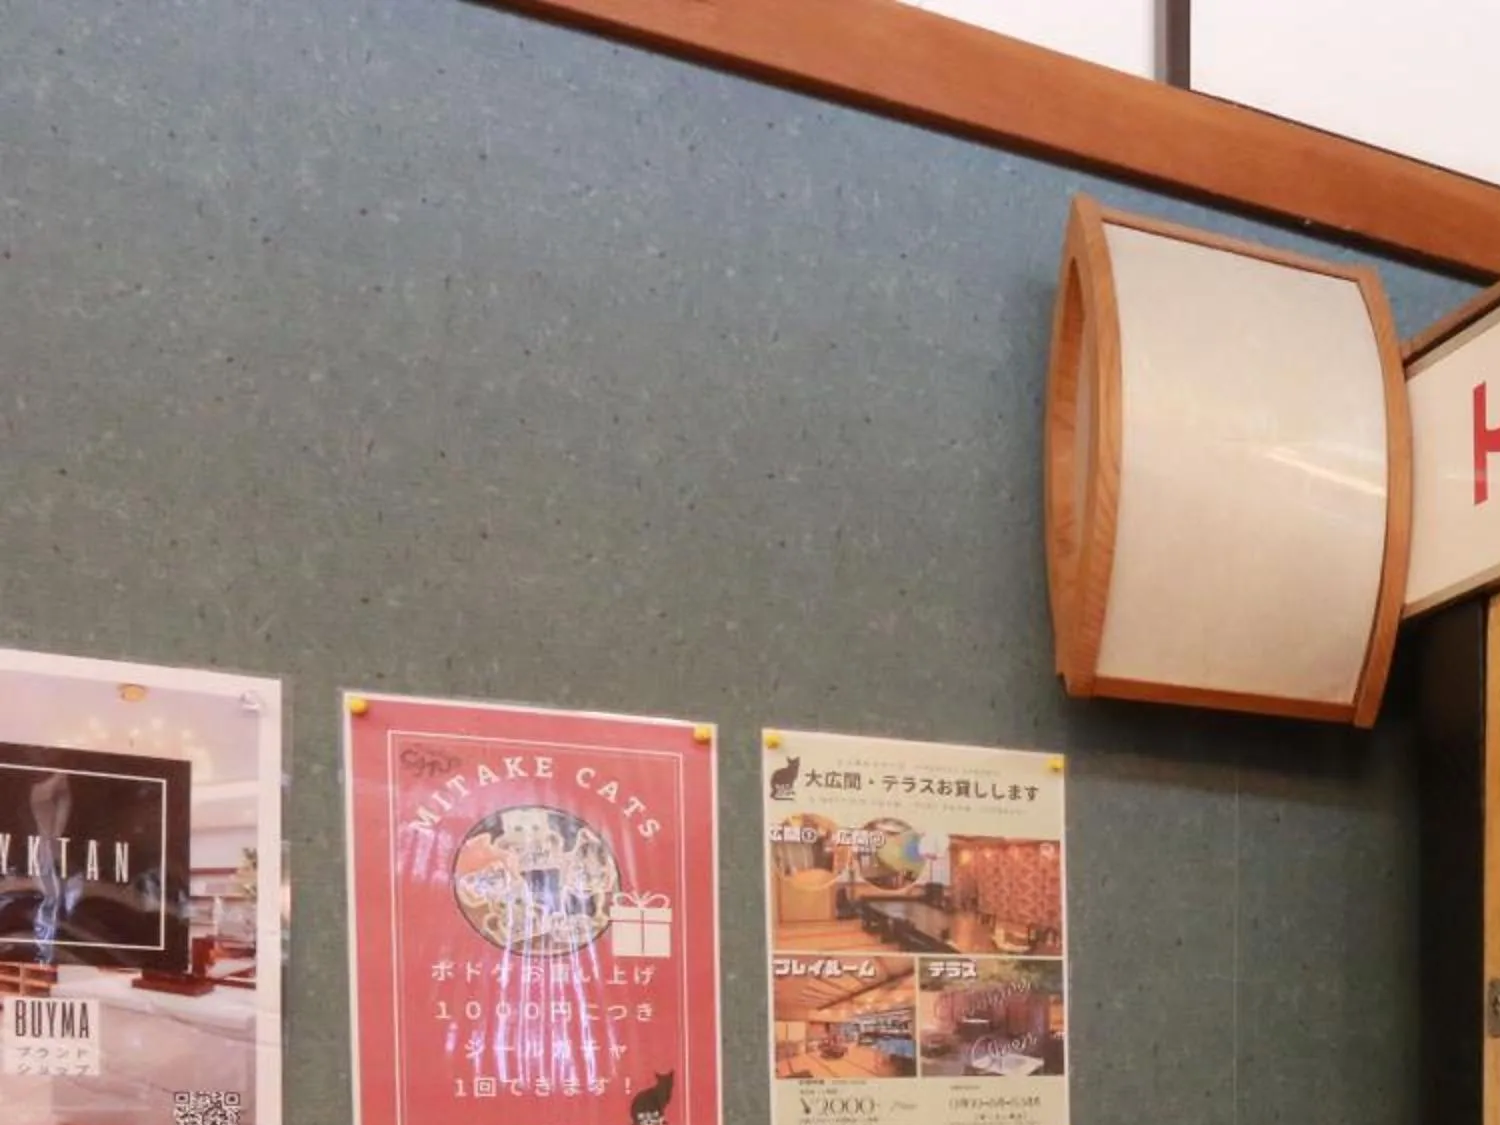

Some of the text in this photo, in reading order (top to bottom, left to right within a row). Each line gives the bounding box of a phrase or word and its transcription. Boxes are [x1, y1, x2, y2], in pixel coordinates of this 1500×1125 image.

[410, 756, 554, 837] MITAKE
[576, 767, 662, 840] CATS
[804, 769, 1039, 801] 大広間・テラスお貸しします
[15, 1000, 91, 1038] BUYMA
